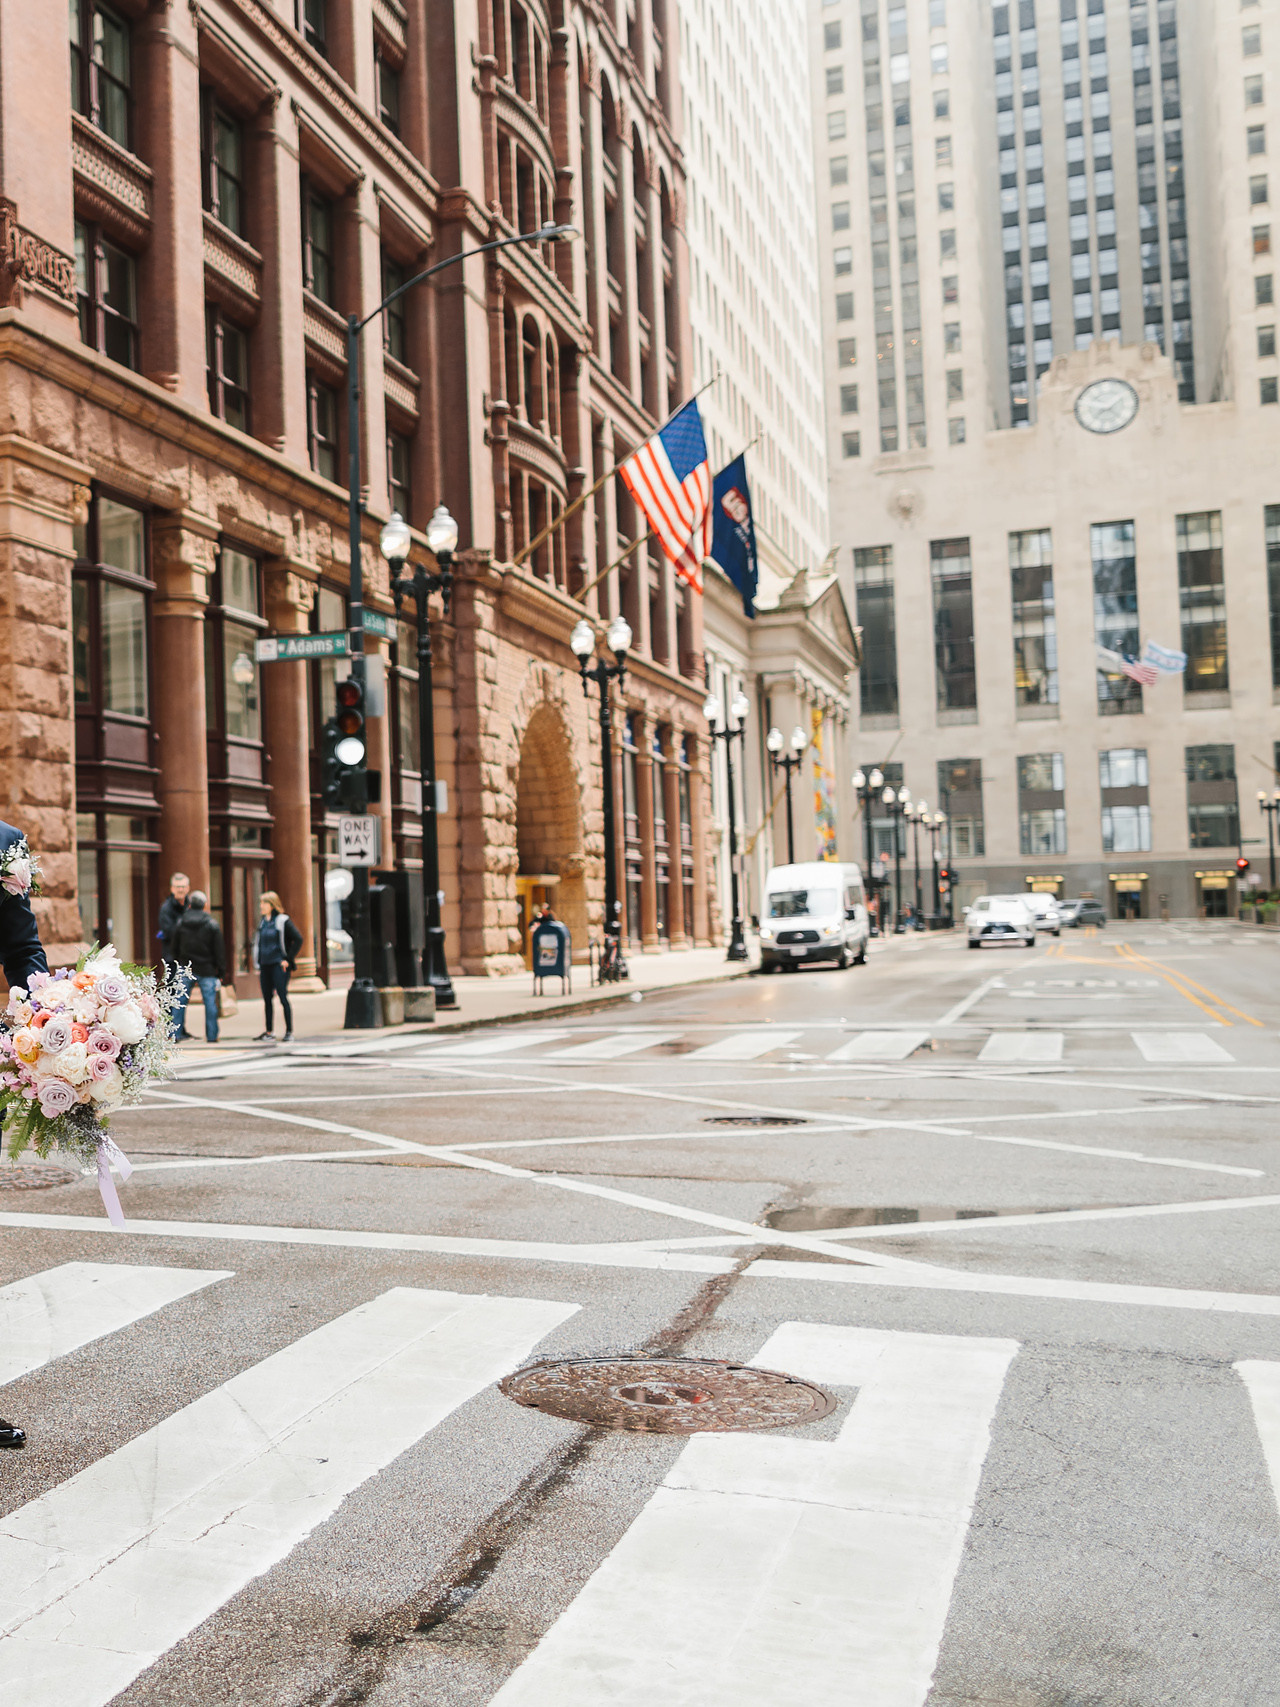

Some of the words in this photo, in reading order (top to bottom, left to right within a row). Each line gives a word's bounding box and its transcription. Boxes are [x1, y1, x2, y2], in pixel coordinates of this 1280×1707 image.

[286, 637, 334, 656] Adams
[336, 636, 345, 648] St
[344, 820, 370, 832] ONE
[344, 834, 370, 845] WAY
